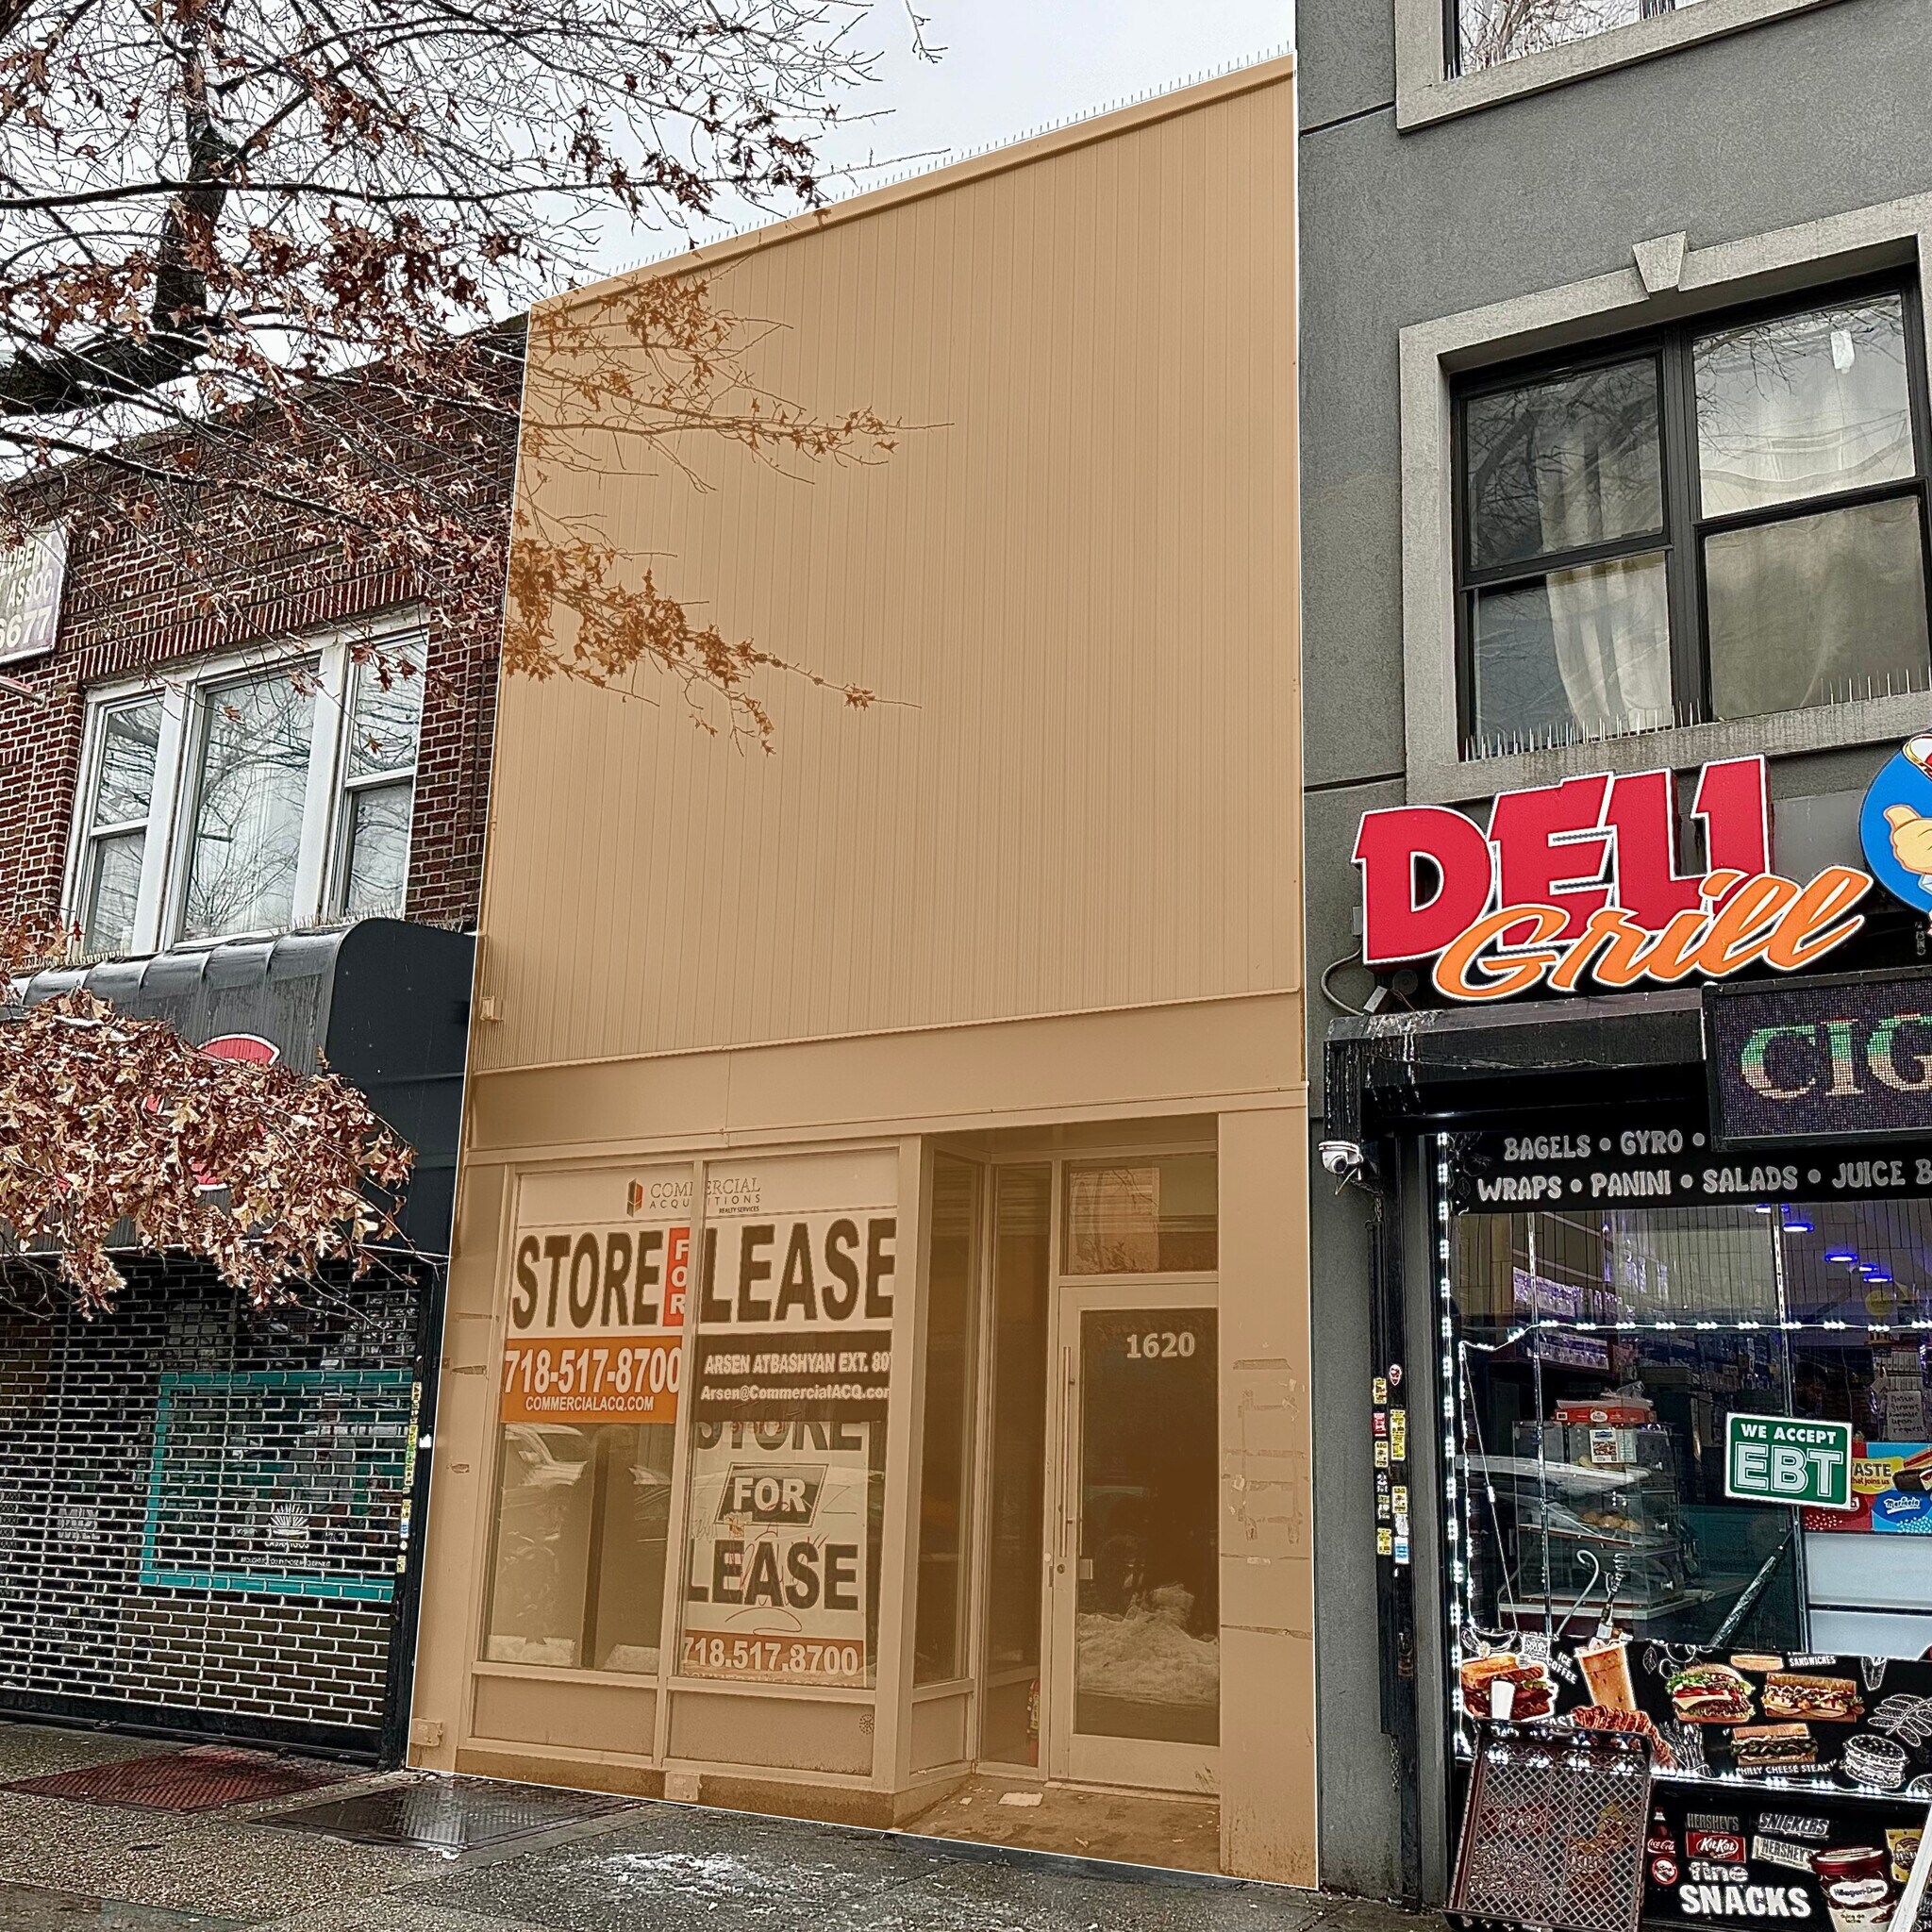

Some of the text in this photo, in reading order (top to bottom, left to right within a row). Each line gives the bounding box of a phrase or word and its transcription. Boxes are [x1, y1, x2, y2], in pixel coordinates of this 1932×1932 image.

[1351, 754, 1771, 964] DELI
[1433, 864, 1874, 1000] Grill
[1504, 1129, 1683, 1161] BAGELS GYRO
[651, 1176, 760, 1199] COMERCIAL
[1477, 1175, 1562, 1202] WRAPS
[1591, 1170, 1672, 1197] PANINI
[1703, 1166, 1798, 1193] SALADS
[1832, 1160, 1906, 1189] JUICE
[649, 1194, 760, 1209] ACQUITIONS
[512, 1230, 664, 1328] STORE
[700, 1217, 897, 1323] LEASE
[1126, 1332, 1195, 1358] 1620
[505, 1347, 682, 1393] 718-517-8700
[704, 1352, 891, 1374] ARSEN ATBASHYAN EXT. 80
[525, 1396, 655, 1411] COMMERCIALACQ.COM
[1740, 1423, 1837, 1445] WE ACCEPT
[1734, 1441, 1844, 1498] EBT
[733, 1477, 807, 1512] FOR
[688, 1539, 859, 1611] LEASE
[684, 1637, 858, 1676] 718.517.8700
[1557, 1651, 1573, 1669] ICE
[1789, 1655, 1837, 1667] SANDWICHES
[1547, 1657, 1577, 1686] COFFEE
[1765, 1765, 1799, 1774] CHEESE
[1687, 1812, 1740, 1832] HERSHEY'S
[1758, 1812, 1829, 1836] SNICKERS
[1689, 1861, 1749, 1882] fine
[1679, 1884, 1811, 1919] SNACKS
